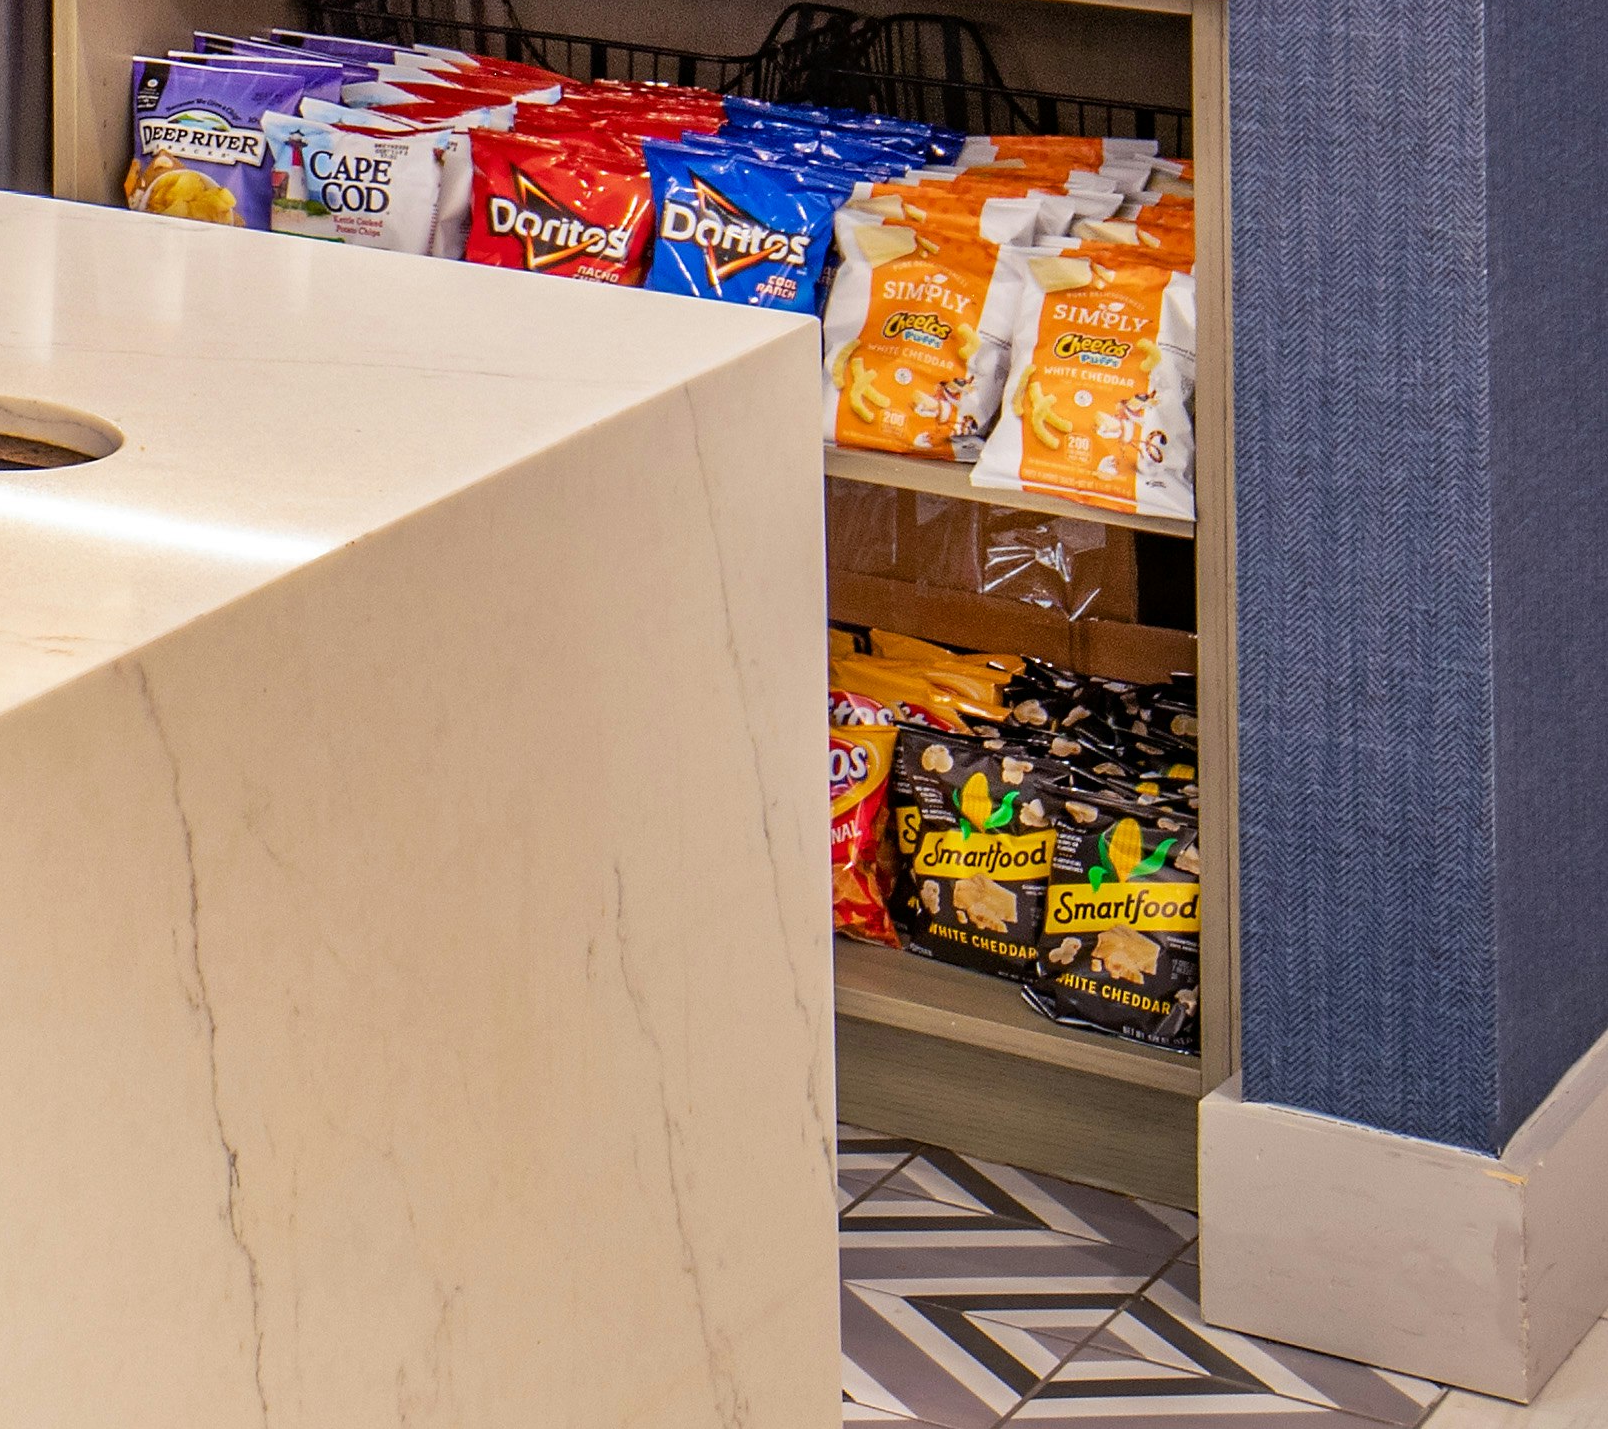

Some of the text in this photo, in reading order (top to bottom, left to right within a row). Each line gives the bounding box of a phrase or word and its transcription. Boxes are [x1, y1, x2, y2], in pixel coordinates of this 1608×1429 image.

[142, 122, 259, 157] DEEP RIVER
[310, 149, 392, 186] CAPE
[321, 182, 390, 214] COD
[332, 215, 383, 229] Kettle Cooked
[357, 226, 381, 238] Chips
[489, 196, 630, 260] Doritos
[660, 199, 812, 265] Doritos
[755, 284, 797, 300] RANCH
[766, 274, 798, 291] COOL
[883, 279, 972, 314] SIMPLY
[883, 311, 952, 342] Cheetos
[1053, 303, 1149, 333] SIMPLY
[903, 328, 944, 349] Puffs
[1054, 332, 1131, 361] Cheetos
[866, 342, 955, 371] WHITE CHEDDAR
[1080, 352, 1121, 369] Puffs
[1043, 365, 1135, 389] WHITE CHEDDAR
[1067, 434, 1090, 451] 200
[923, 834, 1048, 873] Smartfood
[1053, 890, 1199, 925] Smartfood
[971, 934, 1038, 961] CHEDDAR
